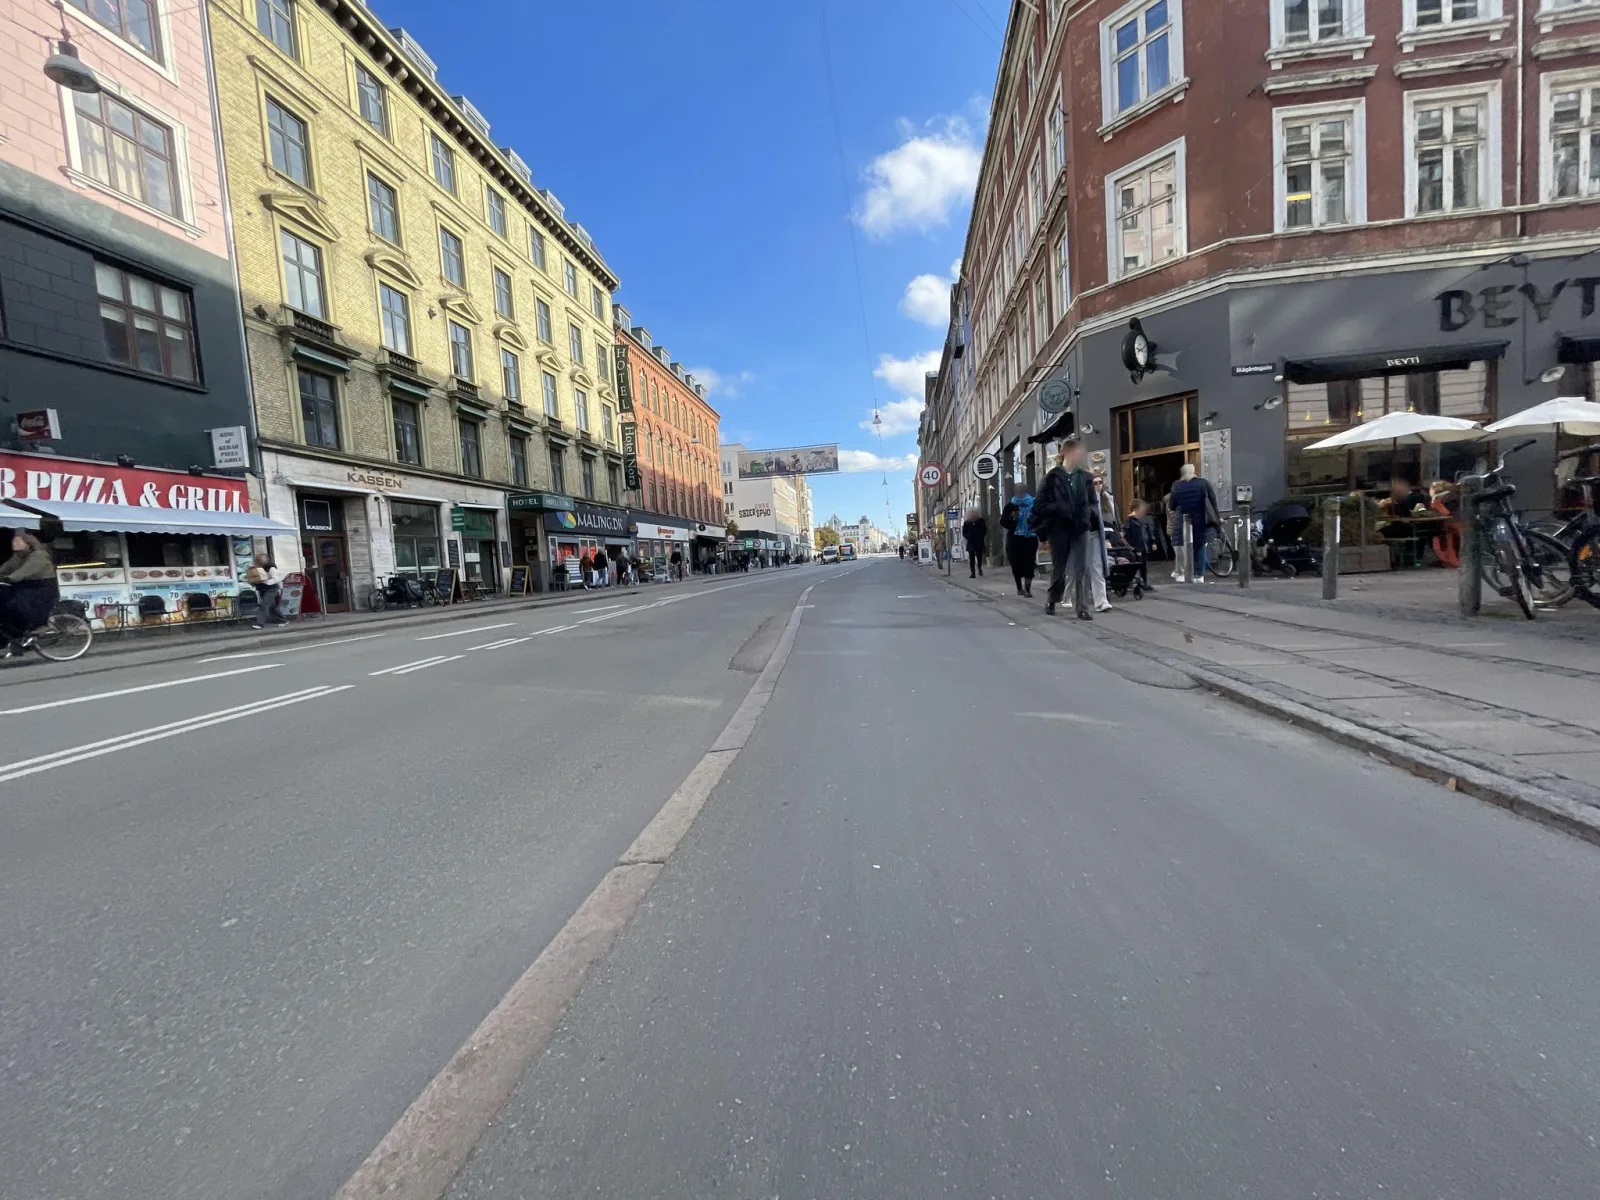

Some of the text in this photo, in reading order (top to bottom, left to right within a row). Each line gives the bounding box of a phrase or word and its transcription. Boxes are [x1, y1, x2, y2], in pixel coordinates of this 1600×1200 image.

[616, 348, 629, 410] HOTEL
[624, 426, 635, 456] Hotel
[347, 472, 402, 489] KASSEN
[627, 459, 637, 486] Nora
[923, 470, 939, 480] 40
[26, 470, 129, 506] PIZZA
[139, 481, 164, 508] &
[168, 484, 245, 513] GRILL
[512, 498, 539, 506] HOTEL
[577, 513, 624, 531] MALING.DK
[101, 596, 113, 604] 70
